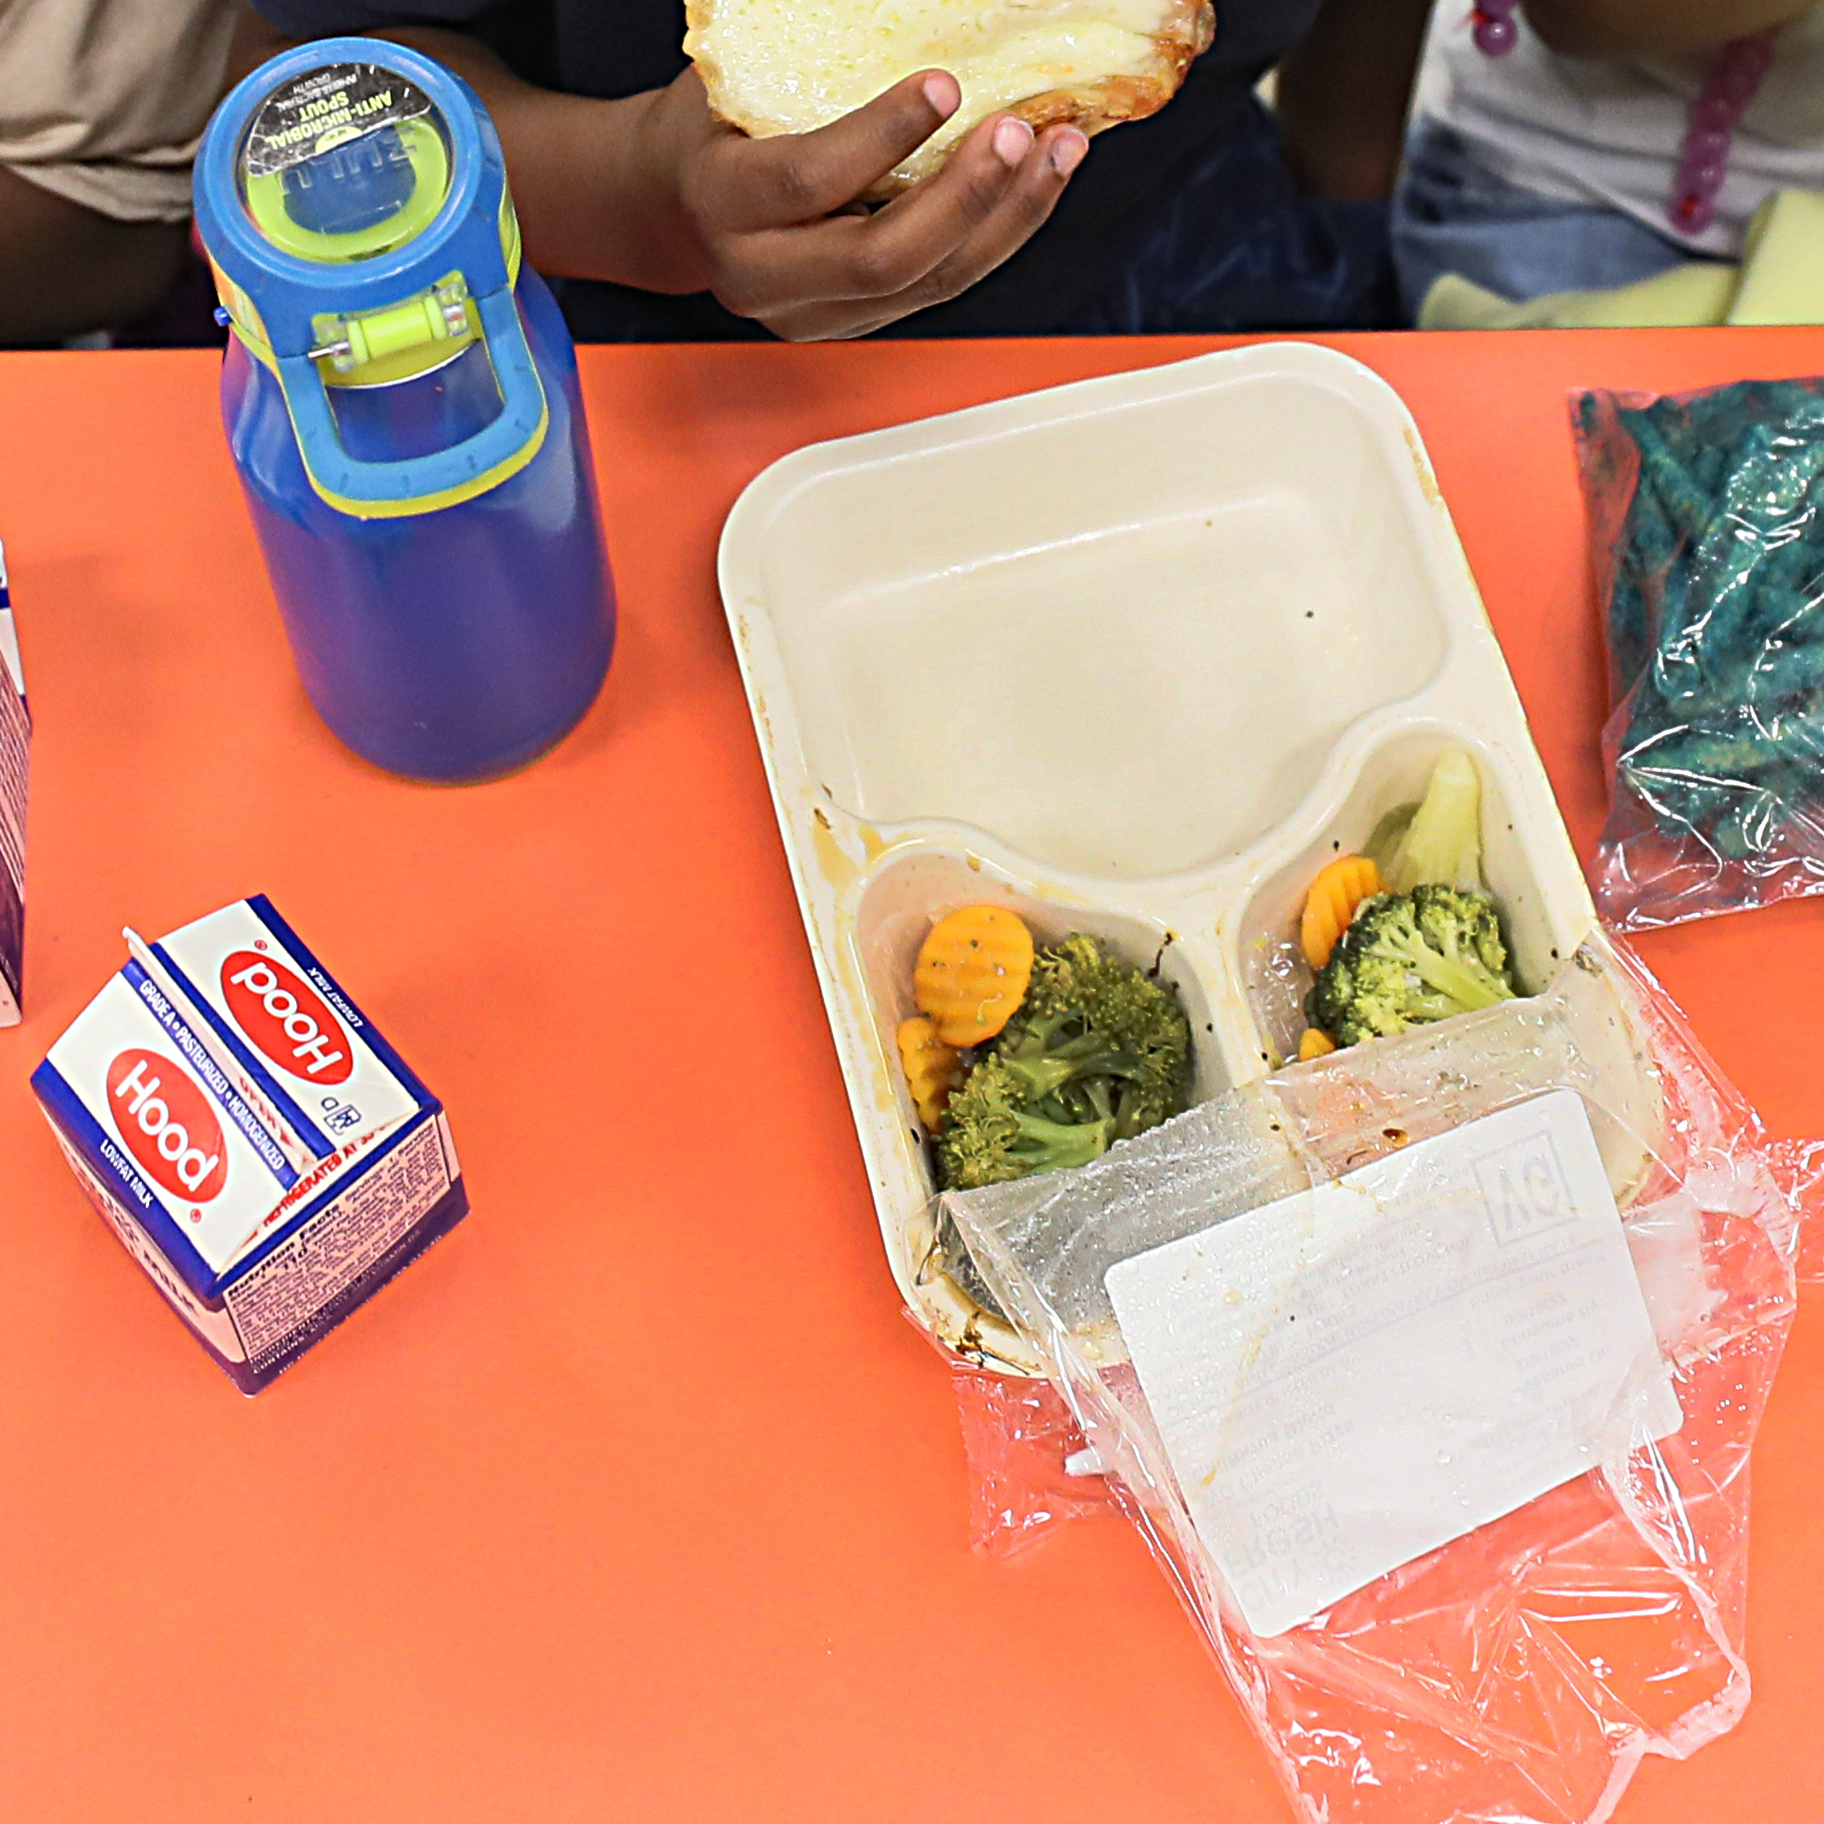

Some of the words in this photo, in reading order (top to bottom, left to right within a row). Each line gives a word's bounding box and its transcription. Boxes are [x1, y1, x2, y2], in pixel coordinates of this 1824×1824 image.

[264, 90, 393, 150] ANTI-MICROBIAL
[298, 91, 349, 122] SPOUT
[231, 960, 343, 1075] Hood
[137, 978, 173, 1018] GRADE
[173, 1026, 231, 1095] PASTEURIZED
[224, 1095, 288, 1170] HOMOGENIZED
[115, 1059, 219, 1192] Hood
[100, 1138, 134, 1184] LOWFAT
[129, 1176, 154, 1209] MILK
[226, 1240, 295, 1297] Nutrition
[298, 1202, 340, 1240] Facts
